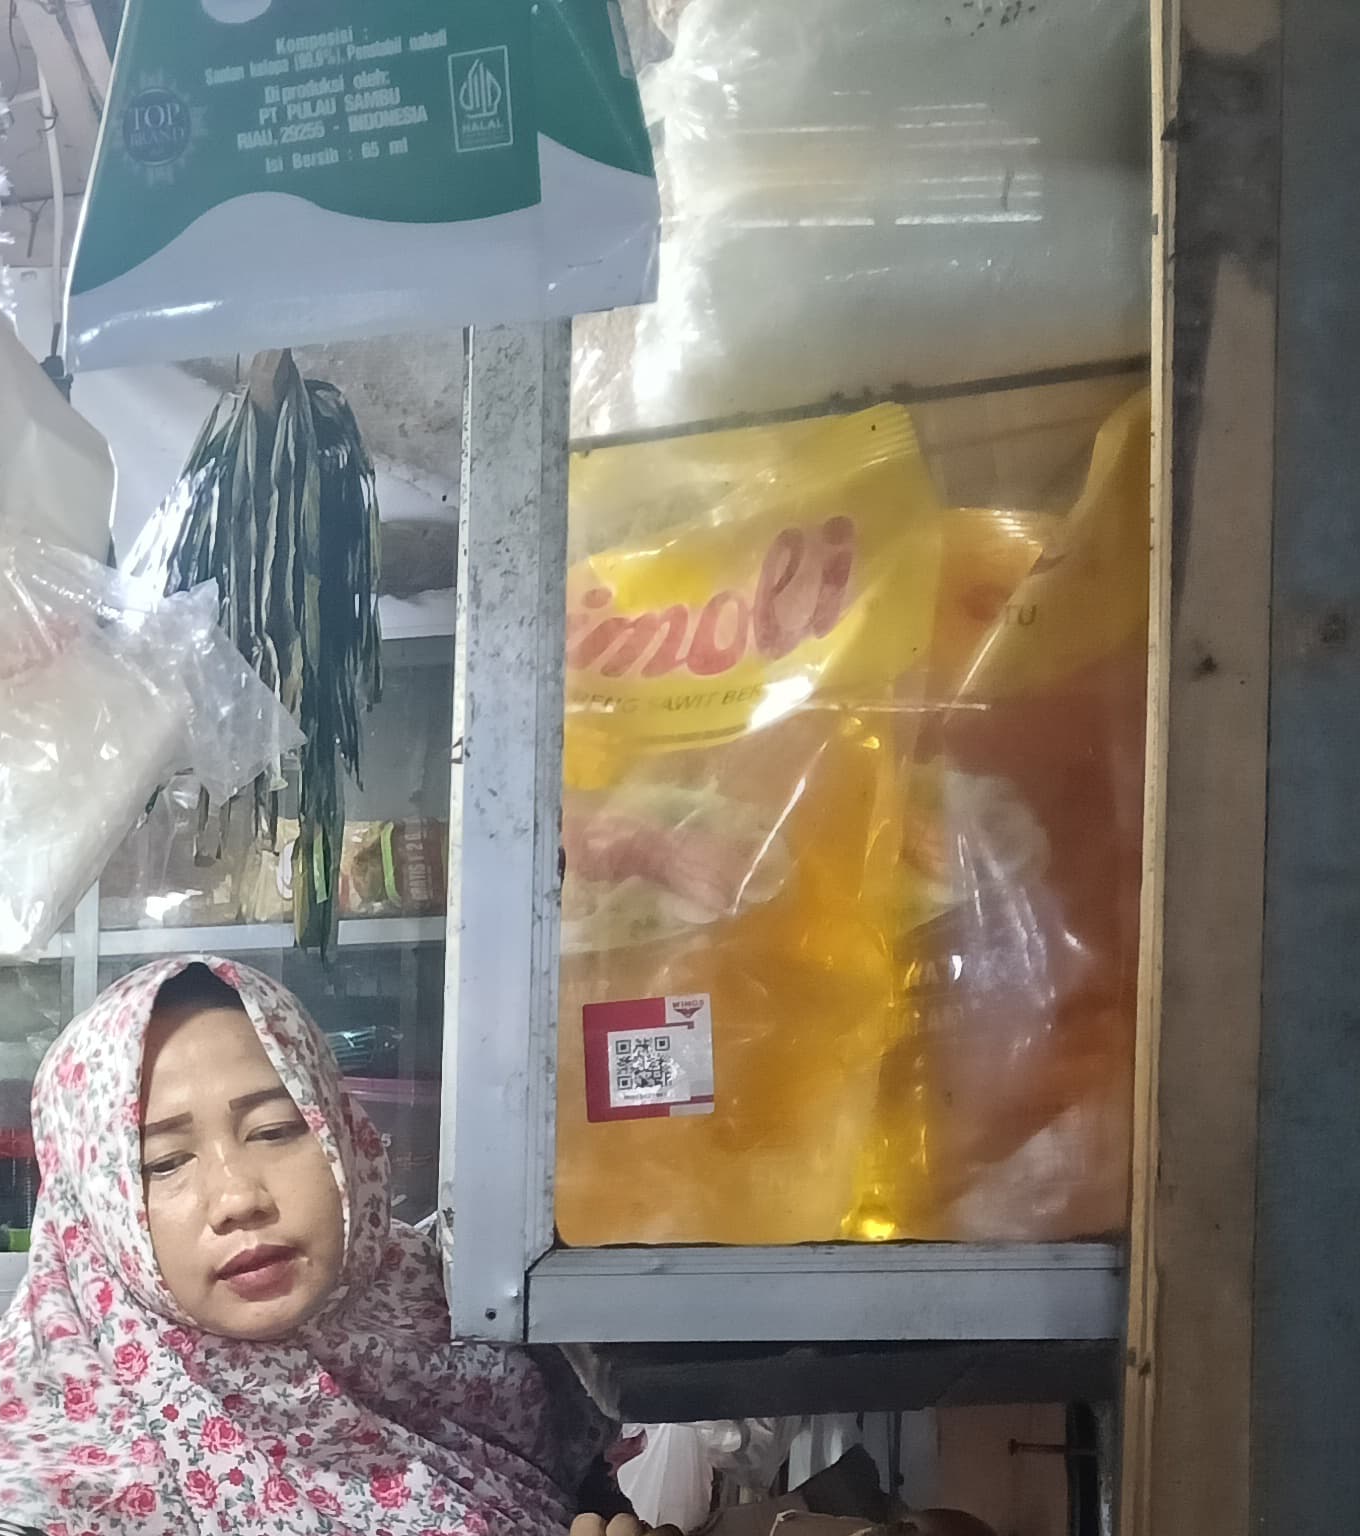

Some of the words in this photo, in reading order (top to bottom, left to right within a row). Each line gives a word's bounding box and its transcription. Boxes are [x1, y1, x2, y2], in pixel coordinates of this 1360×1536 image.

[132, 103, 181, 130] TOP
[259, 106, 278, 125] PT
[287, 98, 336, 121] PULAU
[344, 87, 400, 112] SAMBU
[349, 105, 428, 132] INDONESIA
[462, 119, 504, 133] HALAL
